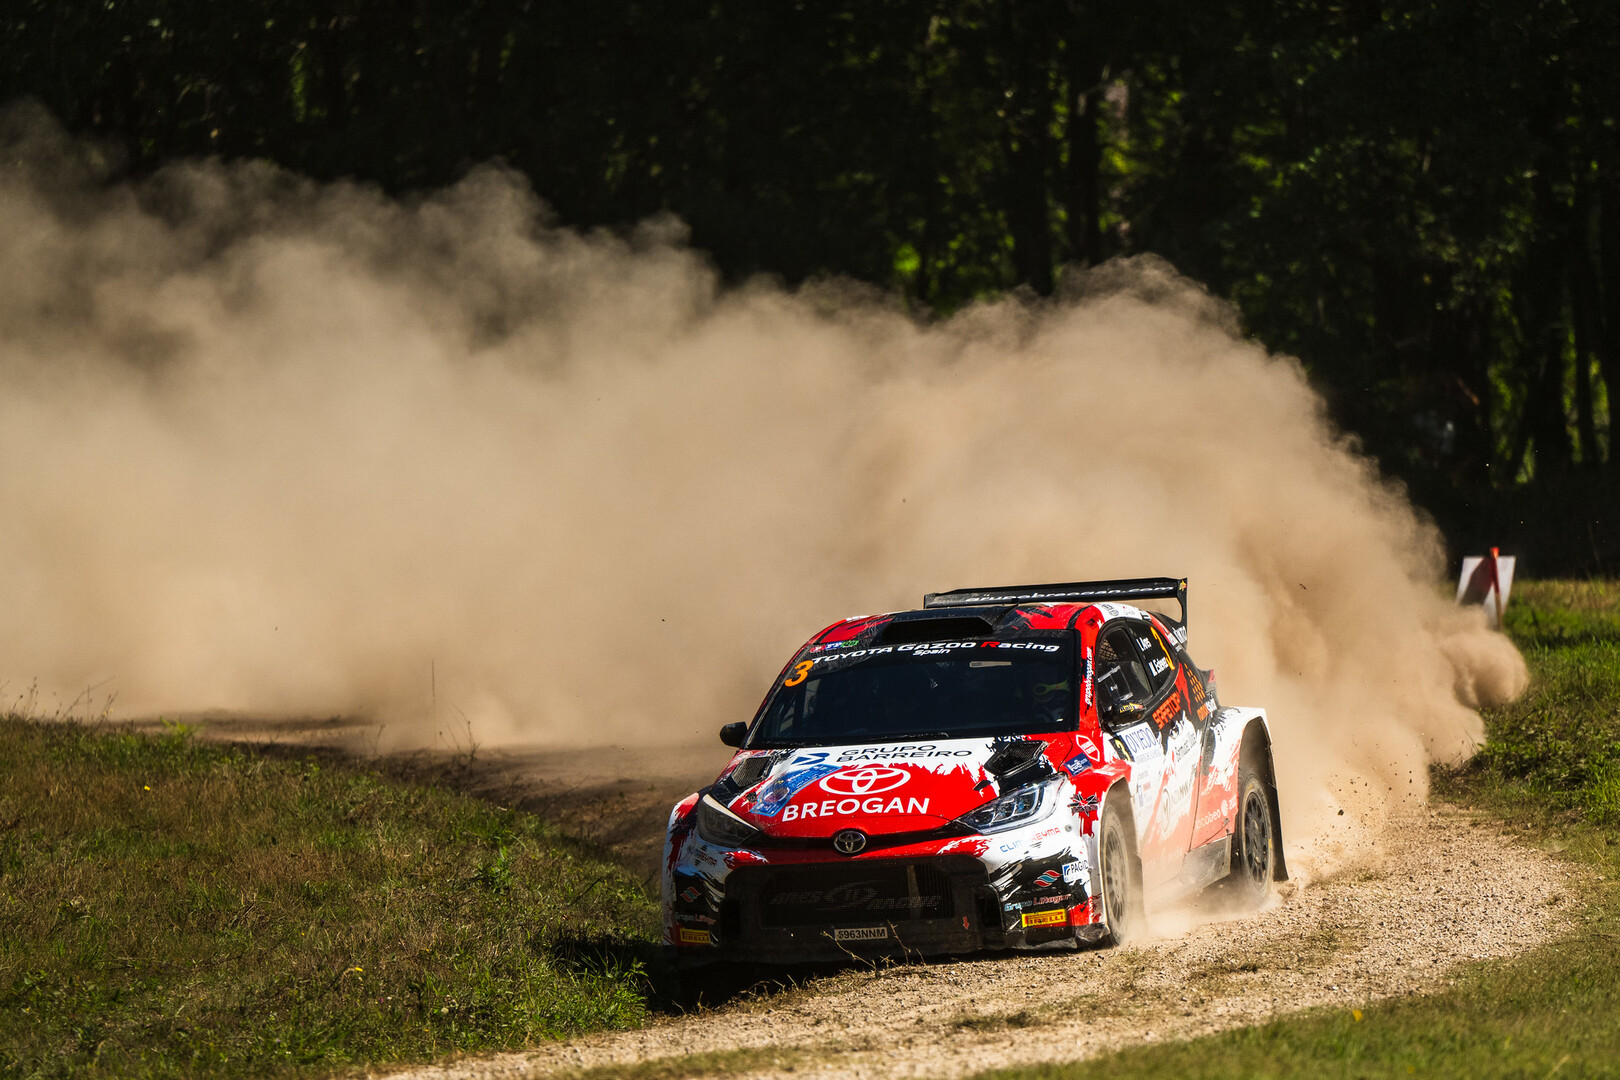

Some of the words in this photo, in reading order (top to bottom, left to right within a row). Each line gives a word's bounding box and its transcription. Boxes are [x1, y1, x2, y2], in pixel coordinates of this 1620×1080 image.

[811, 646, 893, 664] TOYOTA
[897, 641, 977, 652] GAZOO
[980, 640, 1061, 653] Racing
[912, 648, 951, 656] Spain
[1150, 626, 1175, 670] 3
[784, 659, 815, 688] 3
[1151, 690, 1181, 730] SAFETOP
[841, 744, 938, 756] GRUPO
[1114, 738, 1131, 762] 3
[1125, 726, 1158, 754] OVIEDO
[835, 750, 973, 763] BARREIRO
[782, 797, 930, 822] BREOGAN
[1004, 900, 1033, 912] Grupo
[837, 928, 886, 940] 5963NNM
